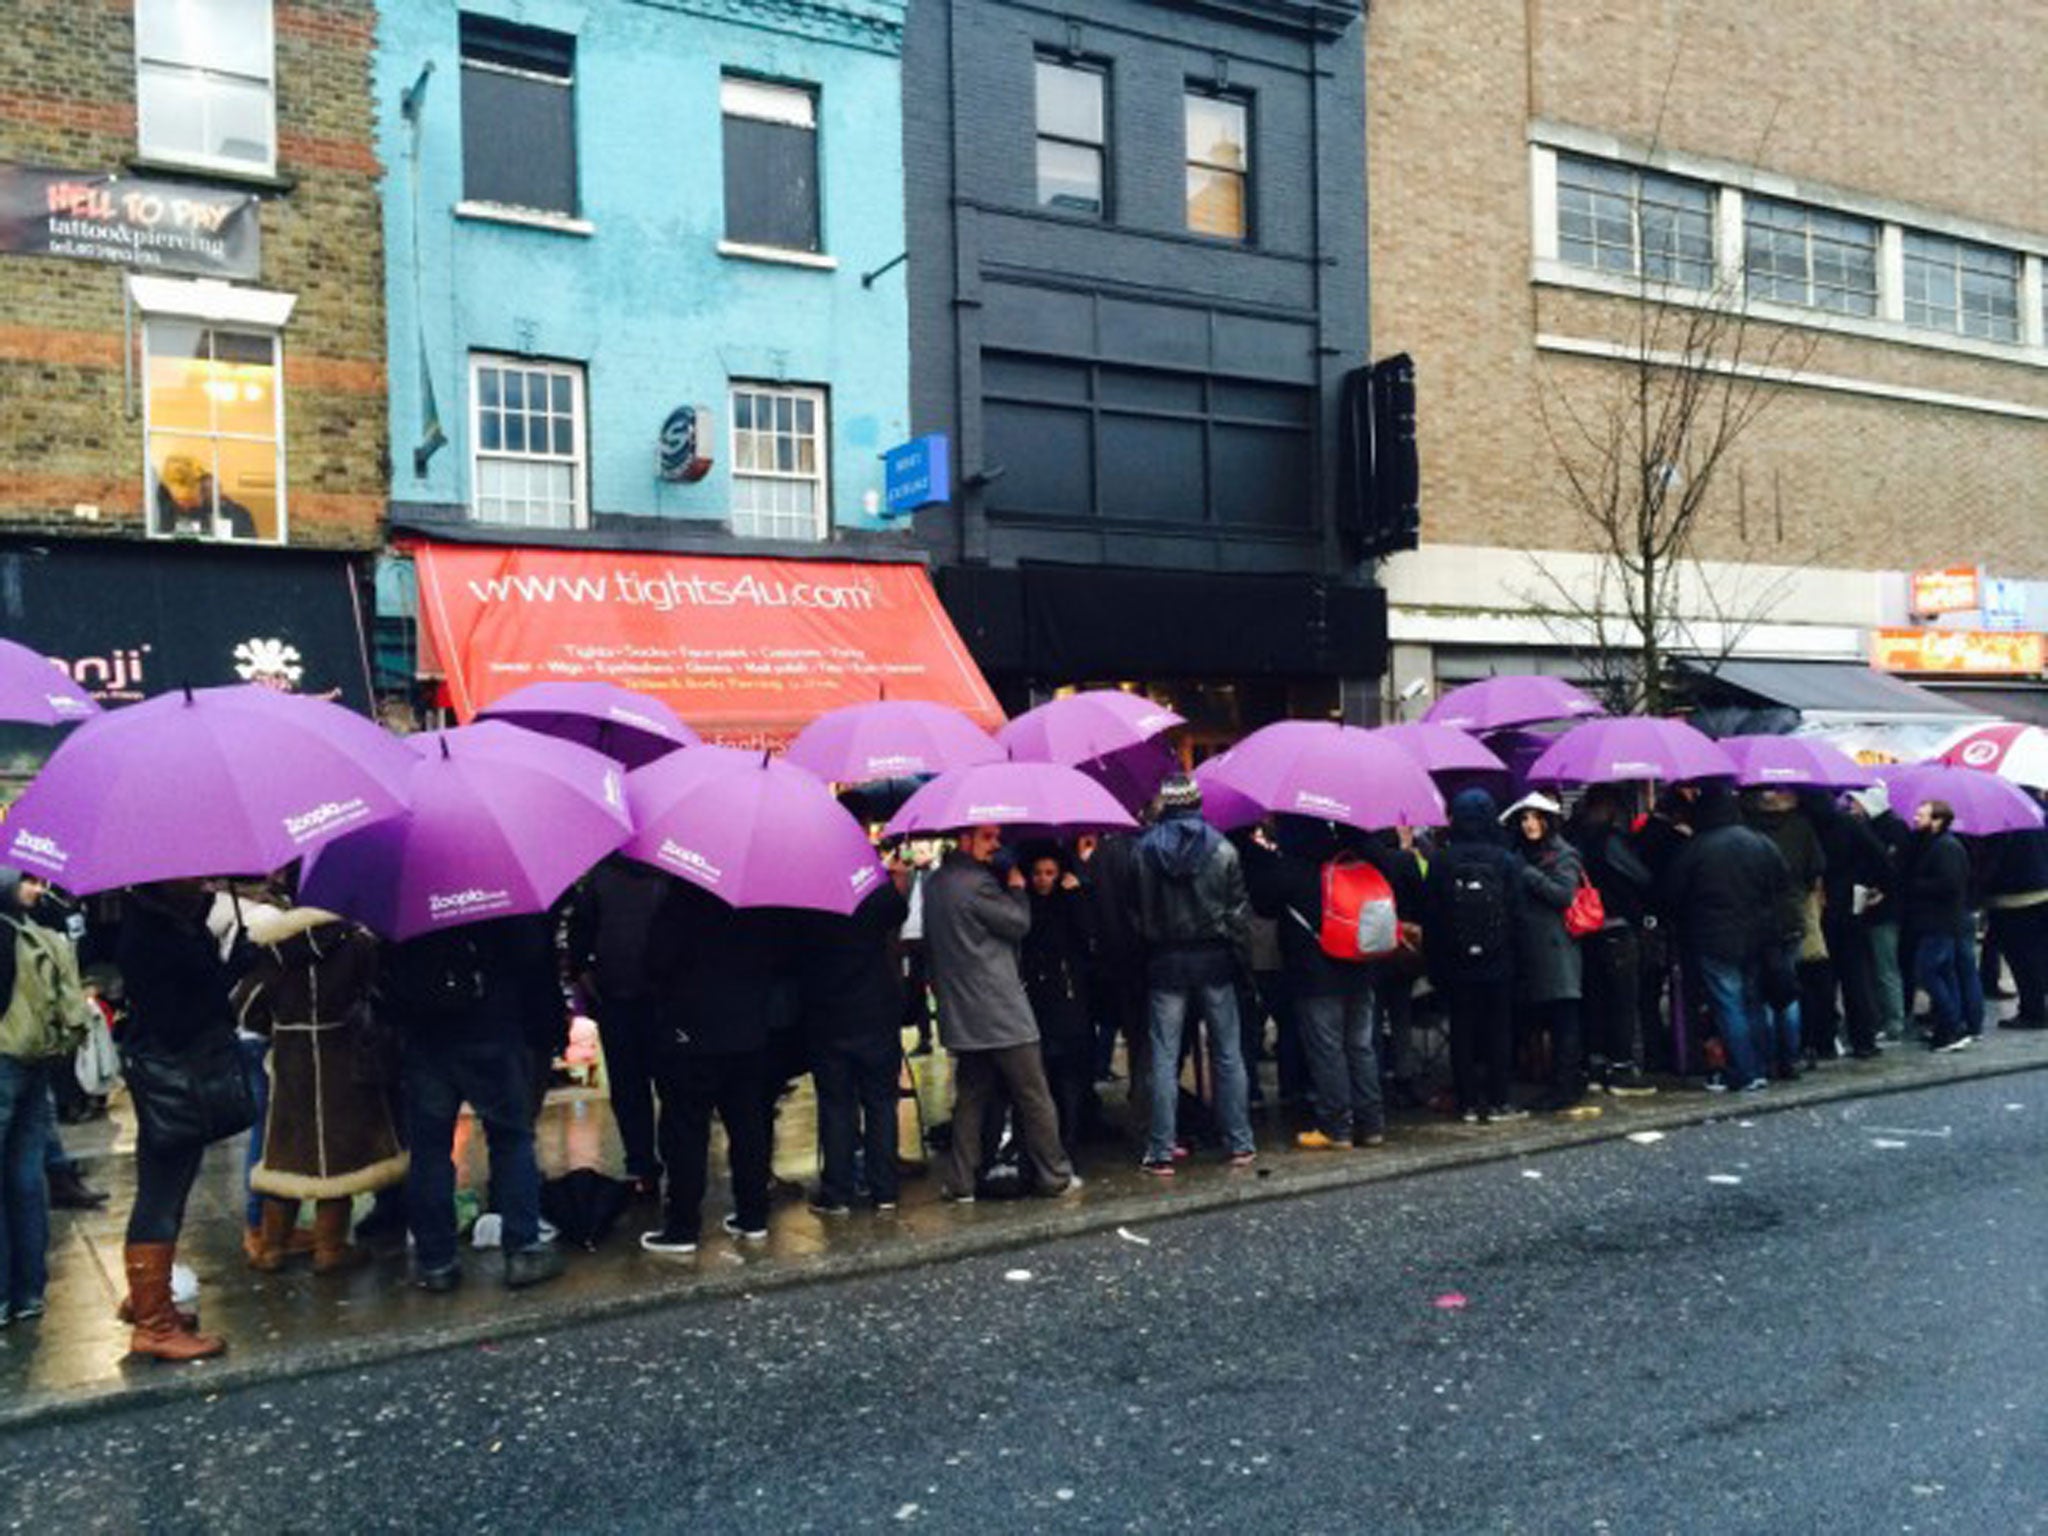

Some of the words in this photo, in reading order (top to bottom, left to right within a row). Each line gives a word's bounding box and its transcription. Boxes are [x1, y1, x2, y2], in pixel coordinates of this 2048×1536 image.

[121, 192, 165, 224] TO
[171, 198, 232, 234] PAY
[468, 571, 876, 612] www.tights4u.com
